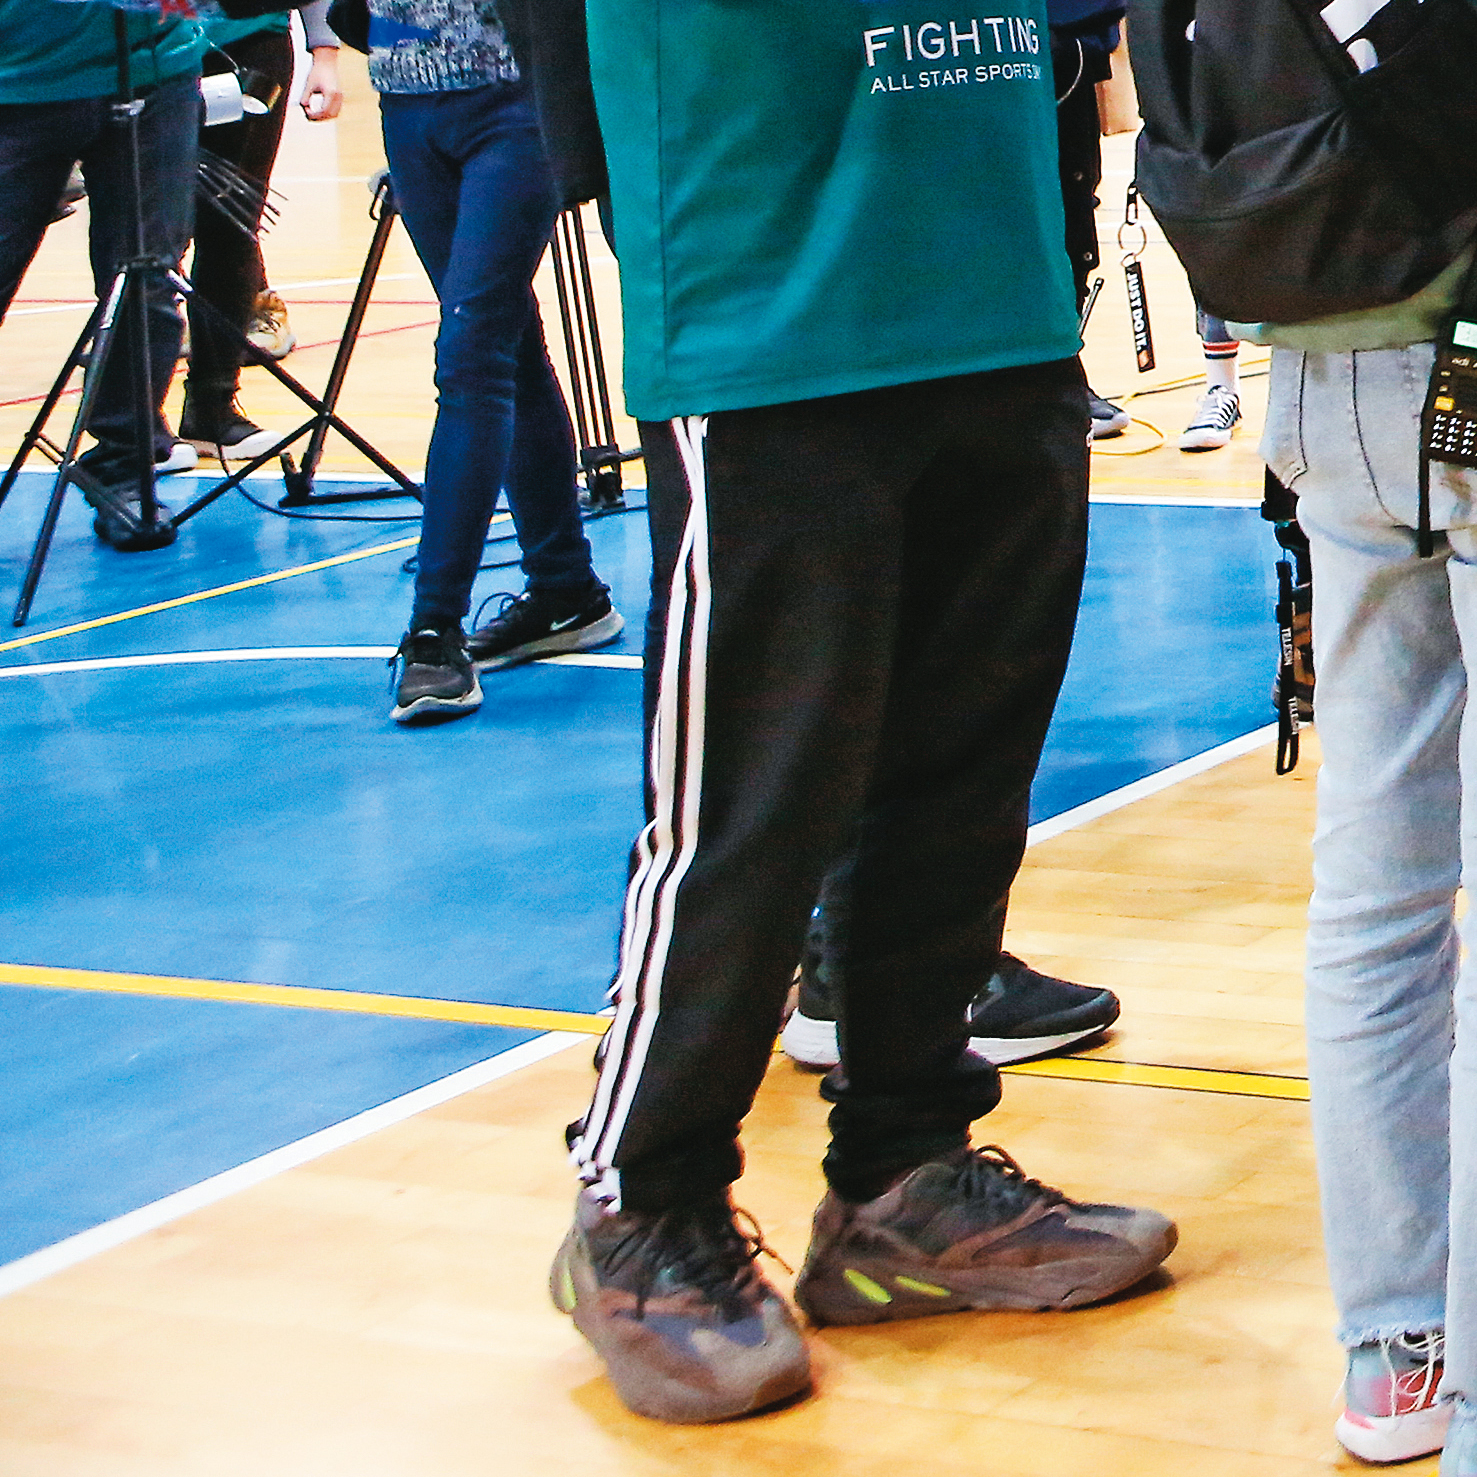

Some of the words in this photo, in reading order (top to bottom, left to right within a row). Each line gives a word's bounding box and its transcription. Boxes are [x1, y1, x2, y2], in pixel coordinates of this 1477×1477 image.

[863, 16, 1040, 68] FIGHTING
[870, 74, 915, 95] ALL
[918, 68, 969, 89] STAR
[1126, 272, 1143, 308] JUST
[1132, 307, 1146, 333] DO
